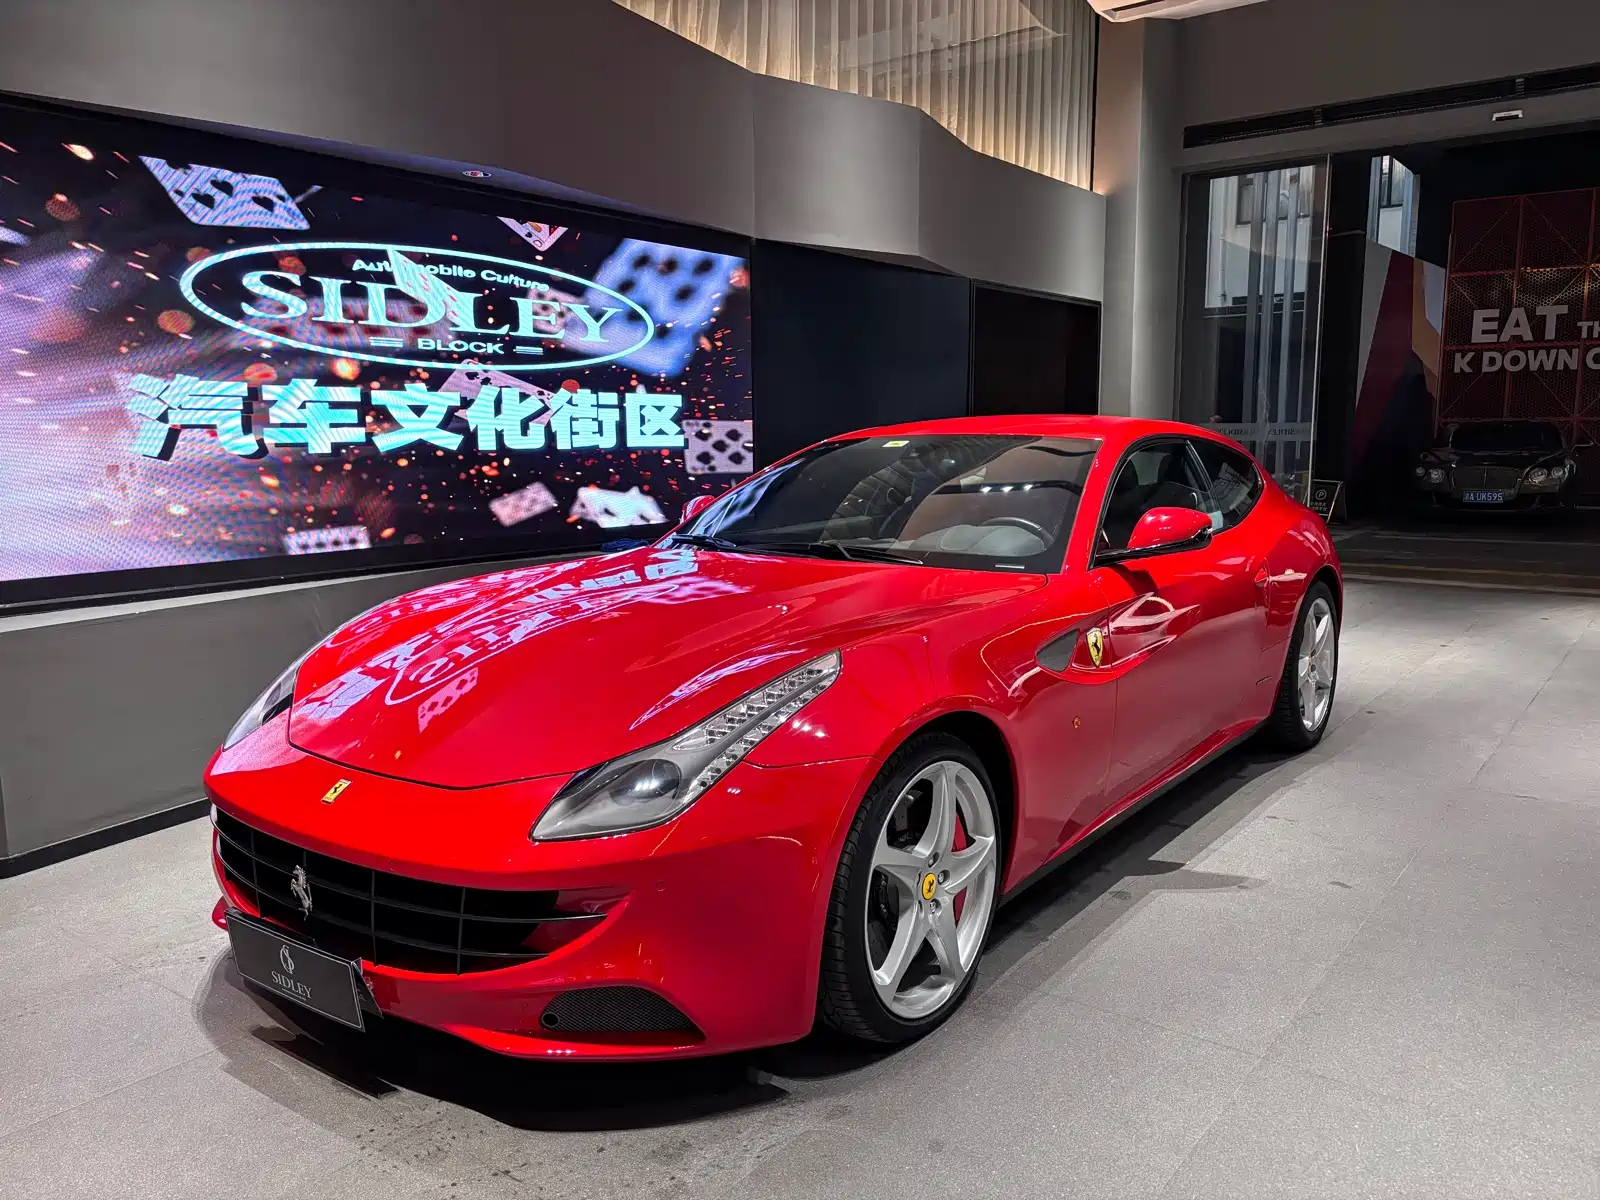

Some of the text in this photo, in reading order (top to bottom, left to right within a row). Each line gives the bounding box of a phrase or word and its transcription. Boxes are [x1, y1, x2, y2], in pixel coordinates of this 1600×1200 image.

[352, 258, 551, 292] Autobile Culture
[240, 269, 624, 343] SIDLEY
[1471, 304, 1569, 344] EAT
[417, 338, 505, 355] BLOCK
[1453, 351, 1475, 373] K
[1481, 348, 1579, 373] DOWN
[126, 373, 684, 457] 汽车文化街区
[271, 970, 312, 999] SIDLEY
